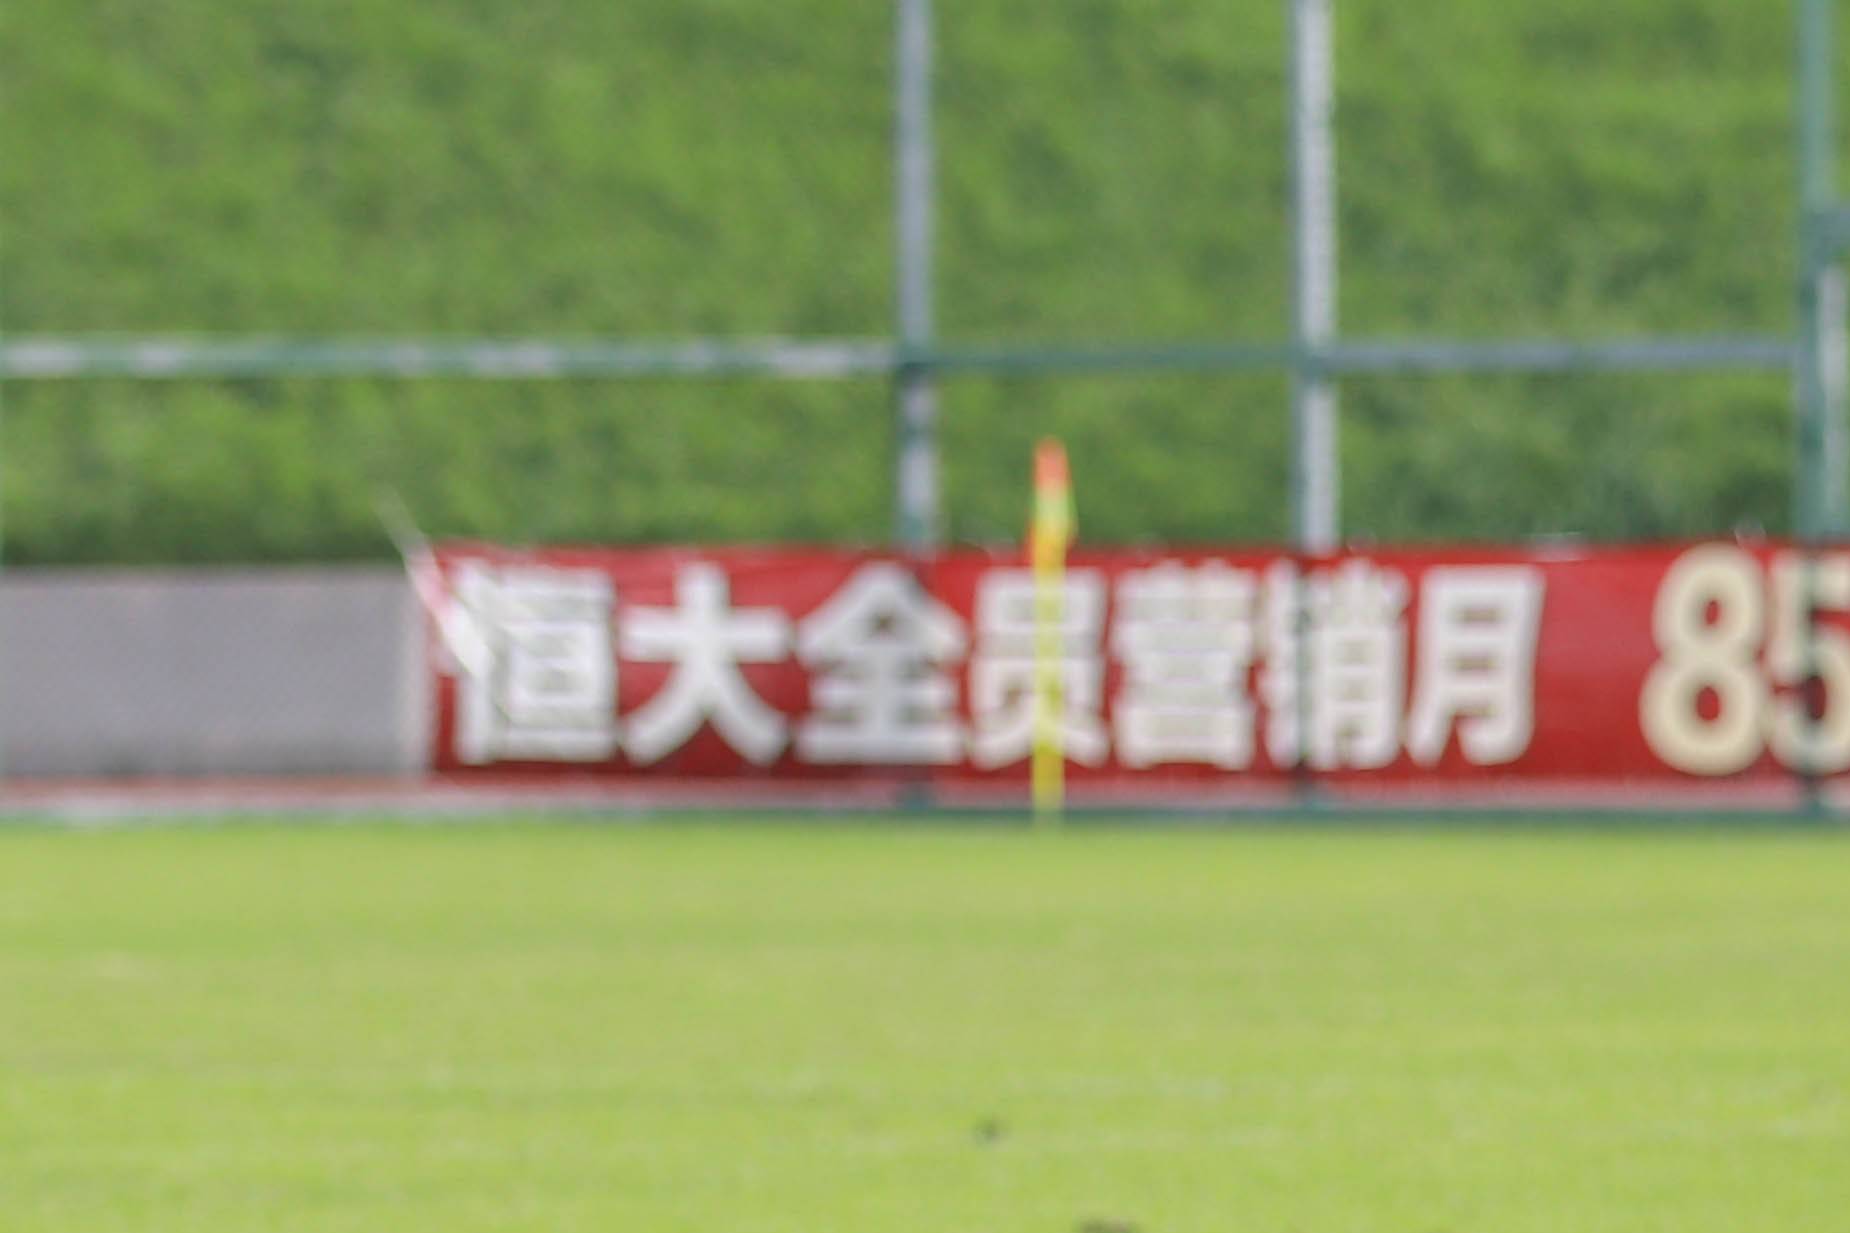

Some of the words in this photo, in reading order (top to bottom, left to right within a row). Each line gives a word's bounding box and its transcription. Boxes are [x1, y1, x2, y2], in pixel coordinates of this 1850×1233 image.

[450, 558, 1545, 772] 恒大全员营销月
